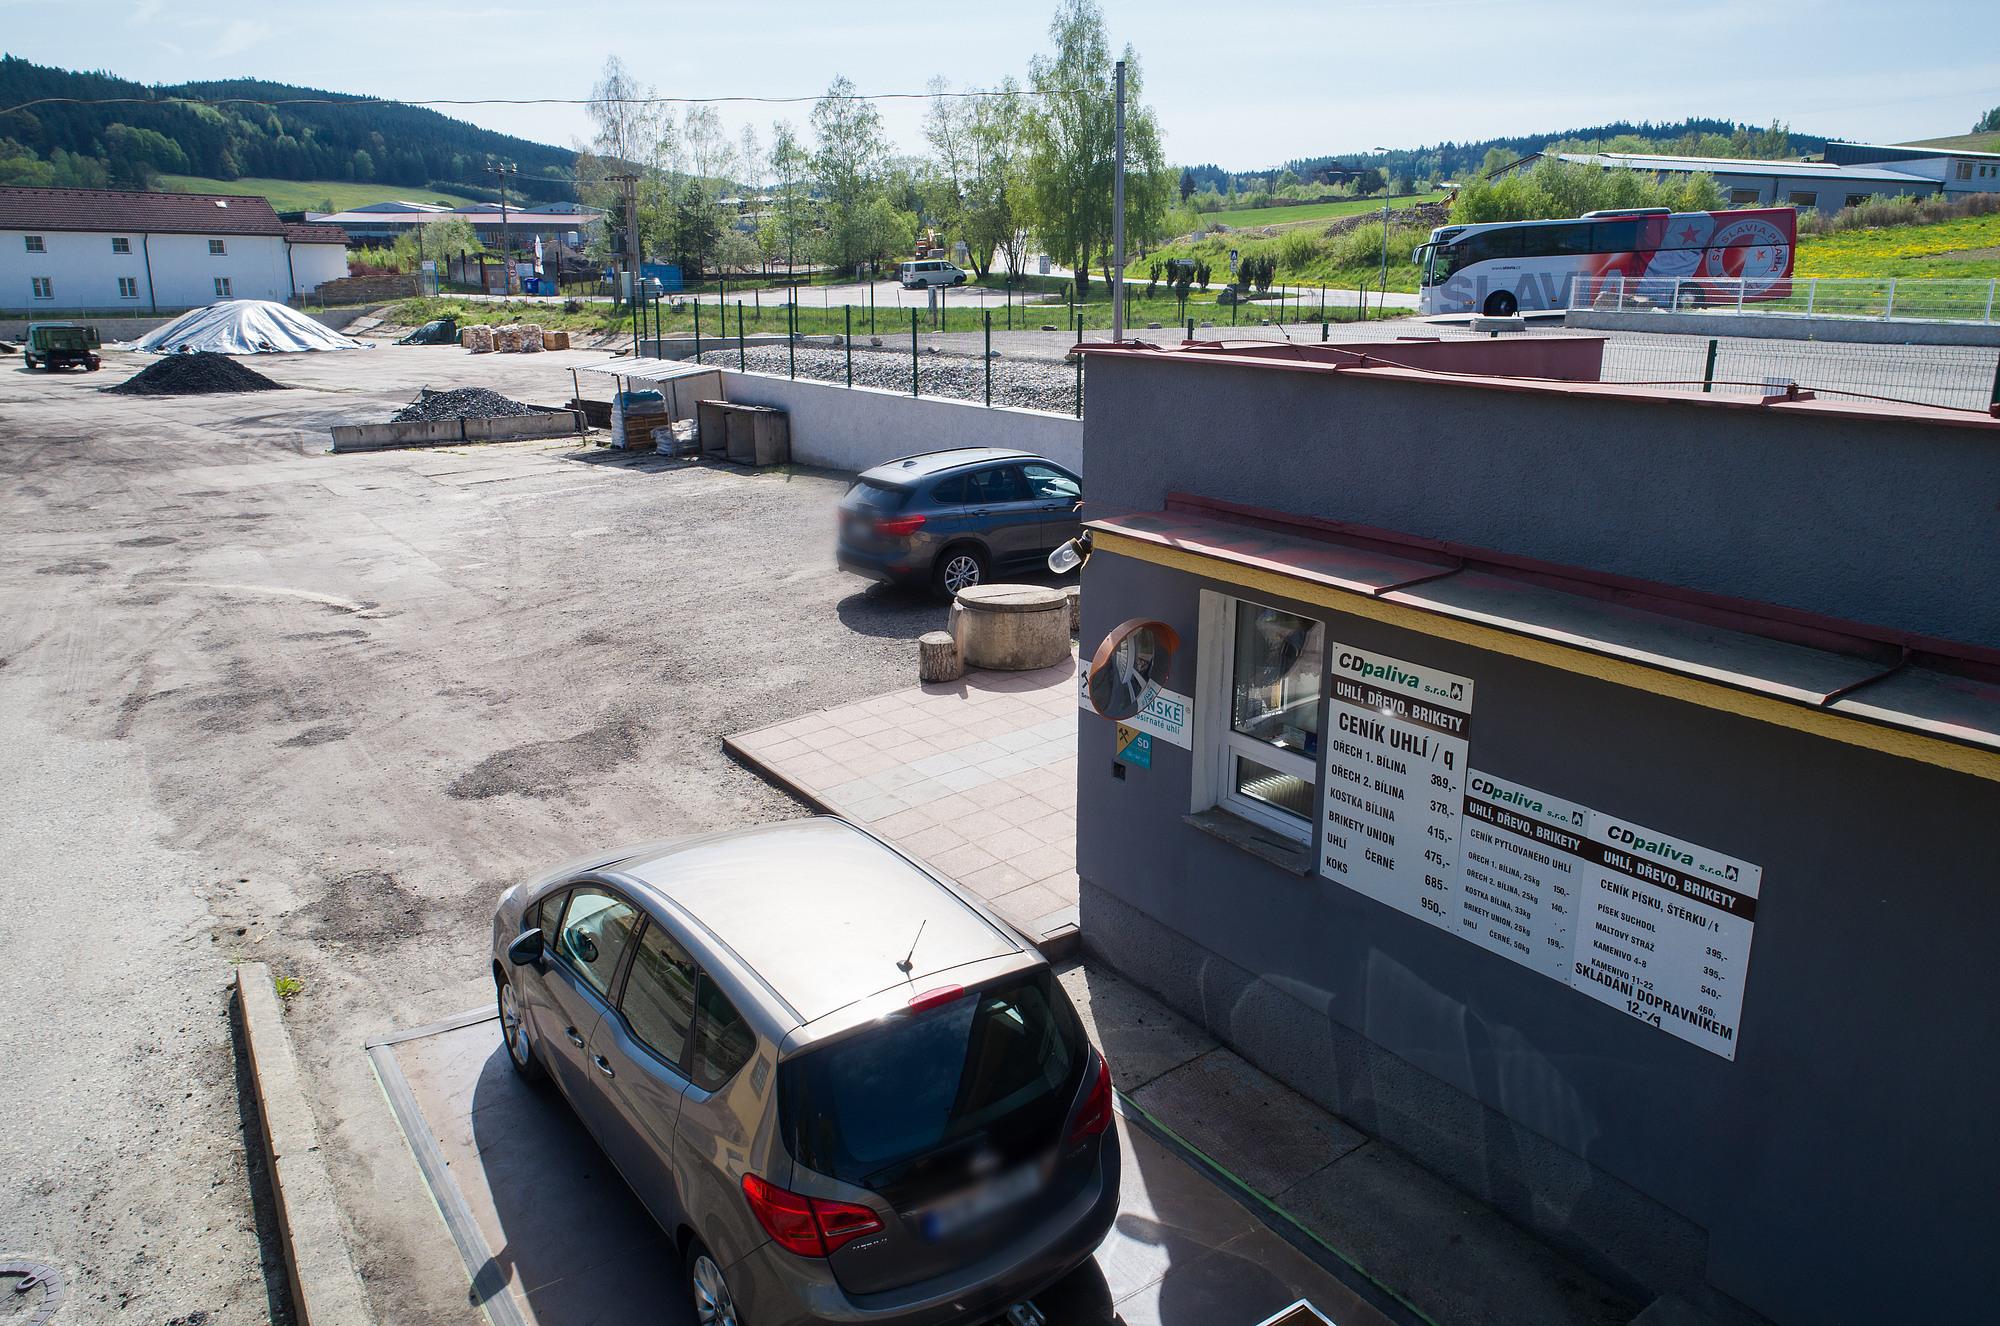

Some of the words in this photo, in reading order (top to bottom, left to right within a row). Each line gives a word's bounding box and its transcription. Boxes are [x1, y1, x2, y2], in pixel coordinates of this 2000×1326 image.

[1722, 224, 1766, 244] SLAVIA
[1339, 652, 1420, 688] CDpaliva
[1424, 685, 1448, 697] s.r.o.
[1148, 700, 1180, 722] NSKÉ
[1336, 682, 1364, 704] UHLÍ,
[1368, 690, 1408, 718] DŘEVO,
[1412, 705, 1462, 732] BRIKETY
[1138, 738, 1149, 748] SD
[1339, 712, 1385, 744] CENÍK
[1390, 728, 1429, 758] UHLÍ
[1444, 750, 1454, 770] q
[1333, 740, 1362, 760] OŘECH
[1366, 752, 1374, 764] 1.
[1376, 752, 1406, 774] BÍLINA
[1430, 774, 1456, 792] 389,-
[1332, 764, 1360, 784] OŘECH
[1364, 776, 1371, 788] 2.
[1374, 780, 1404, 800] BÍLINA
[1430, 800, 1454, 818] 378,-
[1472, 778, 1542, 812] CDpaliva
[1546, 810, 1568, 822] s.r.o.
[1330, 787, 1362, 810] KOSTKA
[1366, 800, 1394, 822] BÍLINA
[1427, 826, 1452, 843] 415,-
[1470, 802, 1494, 822] UHLÍ,
[1497, 812, 1532, 836] DŘEVO,
[1536, 826, 1580, 851] BRIKETY
[1327, 832, 1348, 850] UHLÍ
[1365, 847, 1394, 870] ČERNÉ
[1328, 810, 1364, 832] BRIKETY
[1366, 826, 1394, 846] UNION
[1424, 850, 1450, 868] 475,-
[1470, 829, 1492, 843] CENÍK
[1494, 838, 1550, 866] PYTLOVANÉHO
[1552, 859, 1572, 874] UHLÍ
[1608, 825, 1694, 866] CDpaliva
[1698, 864, 1724, 878] s.r.o.
[1326, 856, 1348, 874] KOKS
[1421, 897, 1446, 916] 950,-
[1522, 891, 1538, 904] 25kg
[1524, 874, 1540, 887] 25kg
[1603, 850, 1632, 874] UHLÍ,
[1636, 863, 1679, 890] DŘEVO,
[1683, 880, 1736, 909] BRIKETY
[1464, 901, 1490, 919] BRIKETY
[1490, 912, 1512, 928] UNION,
[1514, 923, 1530, 936] 25kg
[1465, 885, 1488, 900] KOSTKA
[1514, 906, 1531, 920] 33kg
[1598, 904, 1618, 918] PÍSEK
[1620, 912, 1656, 932] SUCHDOL
[1600, 879, 1629, 898] CENÍK
[1632, 891, 1664, 912] PÍSKU,
[1667, 902, 1706, 928] ŠTĚRKU
[1463, 918, 1478, 930] UHLÍ
[1514, 940, 1530, 954] 50kg
[1593, 940, 1632, 962] KAMENIVO
[1634, 956, 1646, 968] 4-8
[1596, 922, 1629, 942] MALTOVÝ
[1591, 958, 1629, 980] KAMENIVO
[1632, 975, 1654, 990] 11-22
[1575, 962, 1633, 997] SKLÁDÁNÍ
[1637, 988, 1733, 1040] DOPRAVNÍKEM
